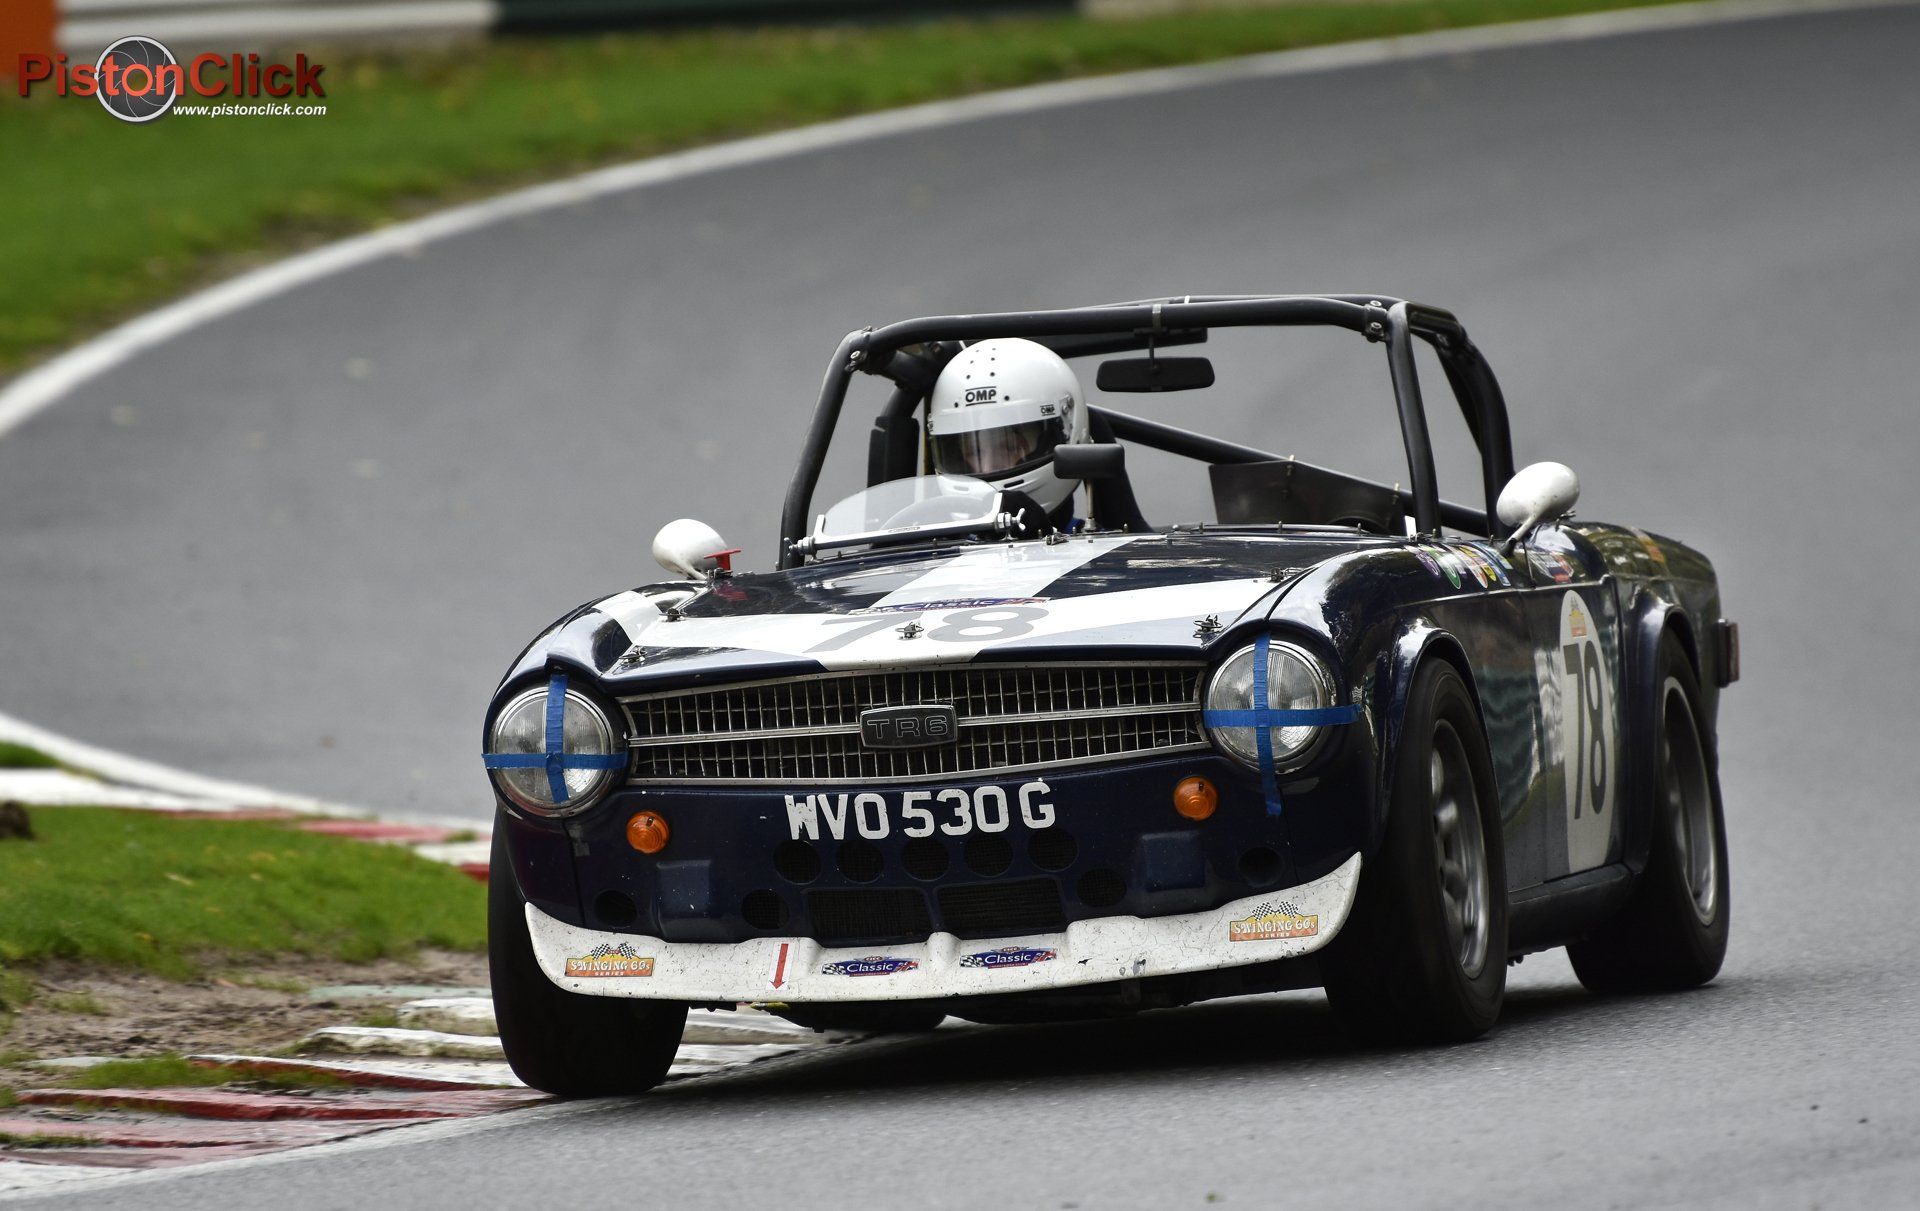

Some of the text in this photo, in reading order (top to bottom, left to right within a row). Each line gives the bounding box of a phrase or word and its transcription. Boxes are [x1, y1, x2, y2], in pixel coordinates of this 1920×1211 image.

[965, 389, 997, 402] OMP
[802, 606, 1050, 653] 78
[866, 715, 948, 740] TR6
[1563, 640, 1606, 820] 78
[784, 781, 1056, 840] WVO 530 G
[1234, 920, 1293, 934] SWINGING
[570, 960, 628, 971] SWINGING
[985, 953, 1031, 964] Classic
[846, 962, 893, 972] Classic
